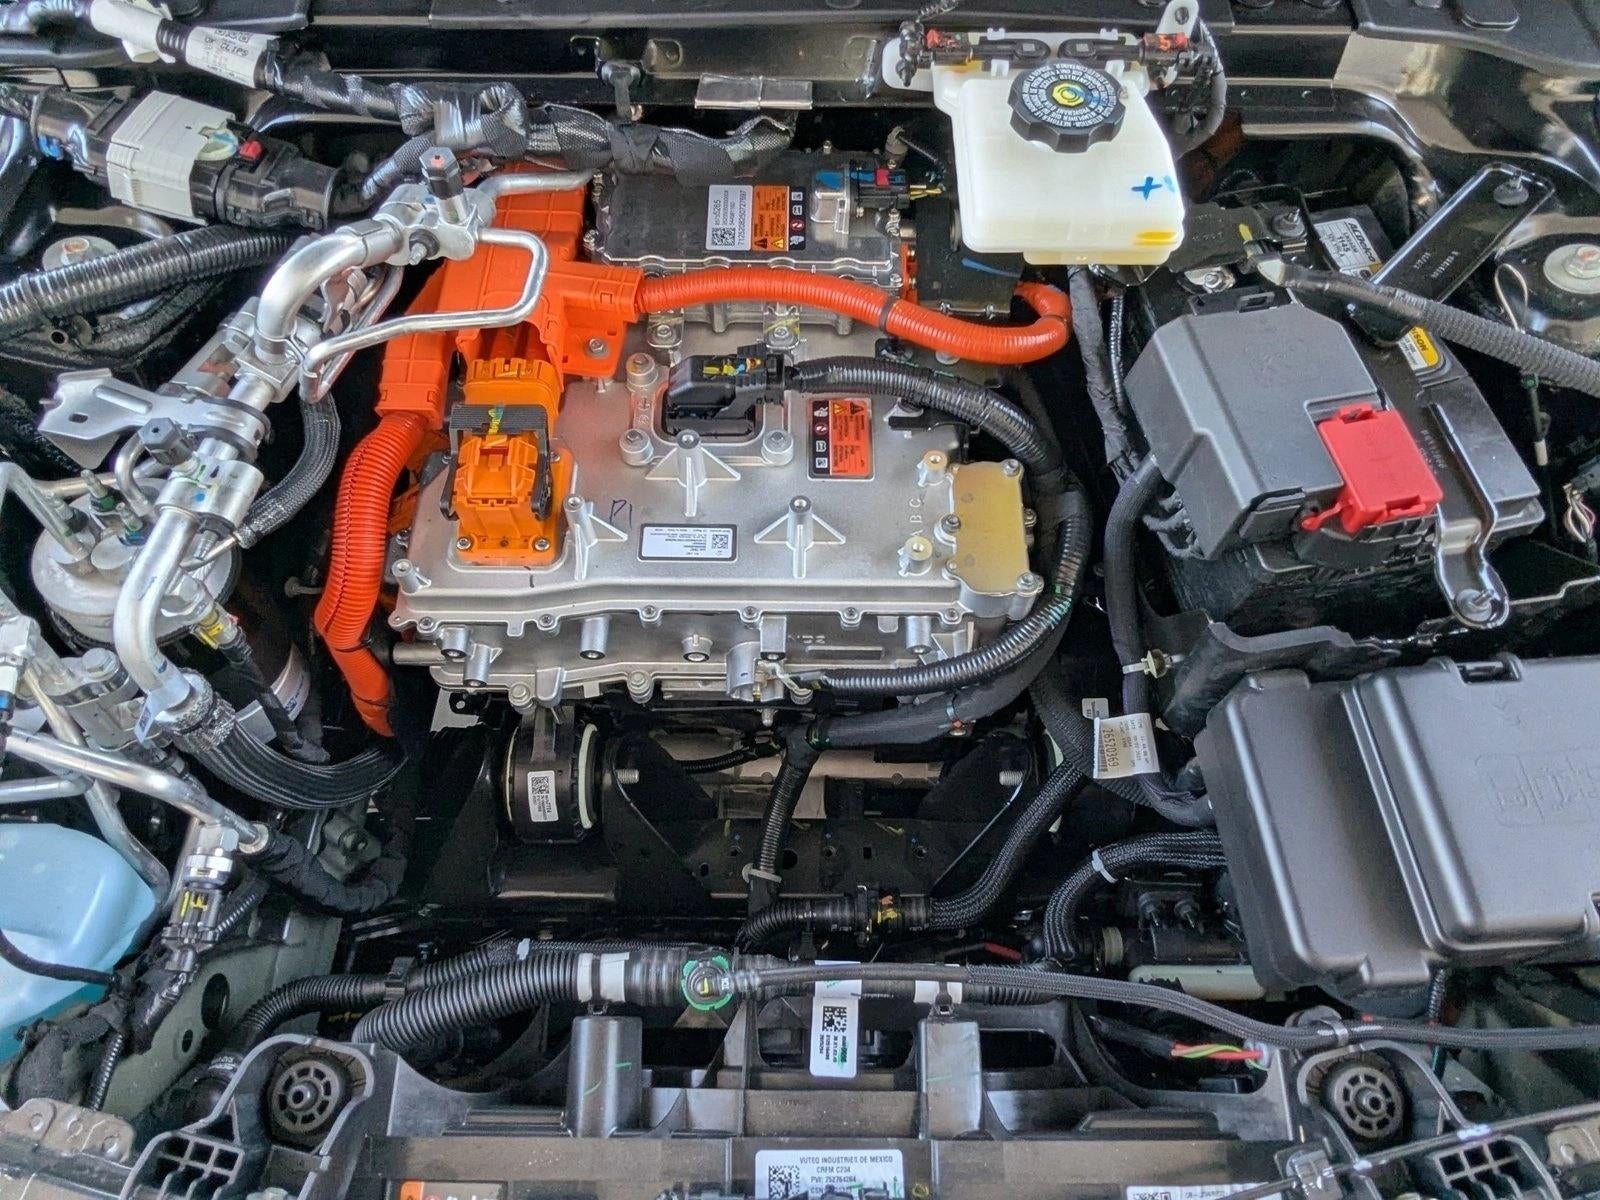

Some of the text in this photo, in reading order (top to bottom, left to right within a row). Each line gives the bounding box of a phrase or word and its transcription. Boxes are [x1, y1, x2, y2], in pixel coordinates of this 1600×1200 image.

[1348, 222, 1376, 262] ACDelco
[908, 498, 922, 508] C
[910, 514, 923, 523] B
[1102, 728, 1120, 767] 26520369
